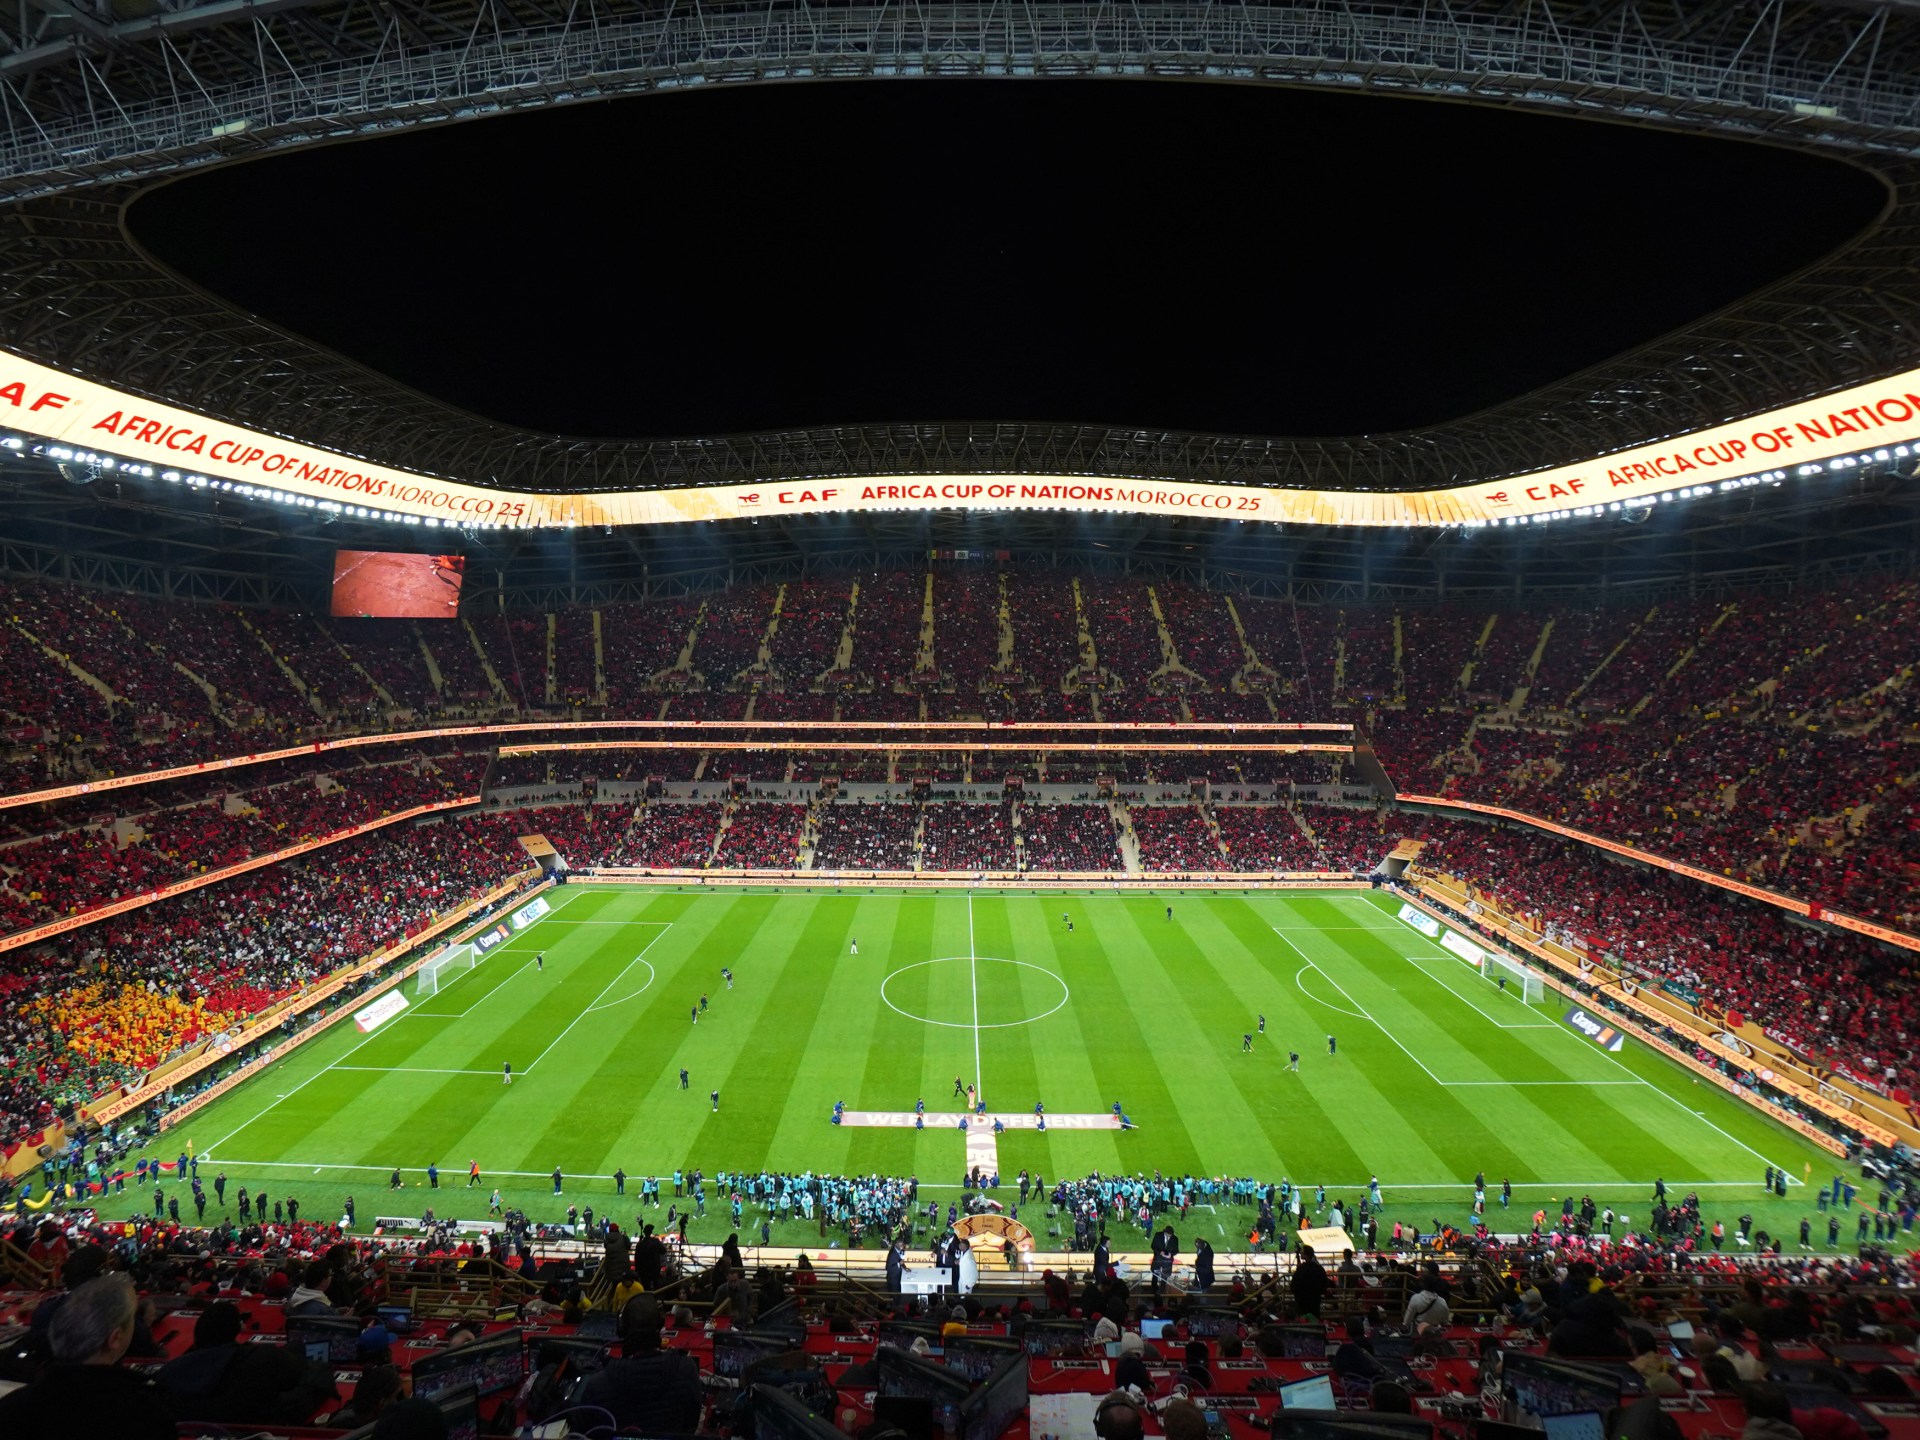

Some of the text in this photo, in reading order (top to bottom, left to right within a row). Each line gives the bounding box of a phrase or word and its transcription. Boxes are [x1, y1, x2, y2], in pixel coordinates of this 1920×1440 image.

[92, 411, 207, 454] AFRICA
[210, 440, 264, 466] CUP
[262, 454, 300, 475] OF
[294, 462, 388, 495] NATIONS
[384, 484, 495, 514] MOROCCO
[498, 502, 525, 517] 25
[1526, 479, 1585, 501] CAF
[1608, 454, 1698, 487] AFRICA
[1693, 440, 1747, 466] CUP
[1751, 427, 1793, 452] OF
[778, 485, 1261, 511] CAF AFRICA CUP OF NATIONS MOROCCO 25
[28, 789, 64, 801] MOROCCO
[64, 787, 72, 795] 25
[8, 897, 143, 946] CAF AFRICA CUP OF NATIONS MOROCCO 25
[108, 1101, 123, 1117] OF
[124, 1079, 162, 1109] NATIONS
[161, 1056, 202, 1088] MOROCCO
[203, 1053, 211, 1064] 25
[180, 1089, 212, 1117] NATIONS
[211, 1067, 246, 1097] MOROCCO
[245, 1063, 254, 1075] 25
[866, 1113, 903, 1125] WE
[1768, 1104, 1792, 1125] CAF
[1800, 1122, 1833, 1149] AFRICA
[1804, 1090, 1833, 1114] CAF
[1841, 1110, 1879, 1139] AFRICA
